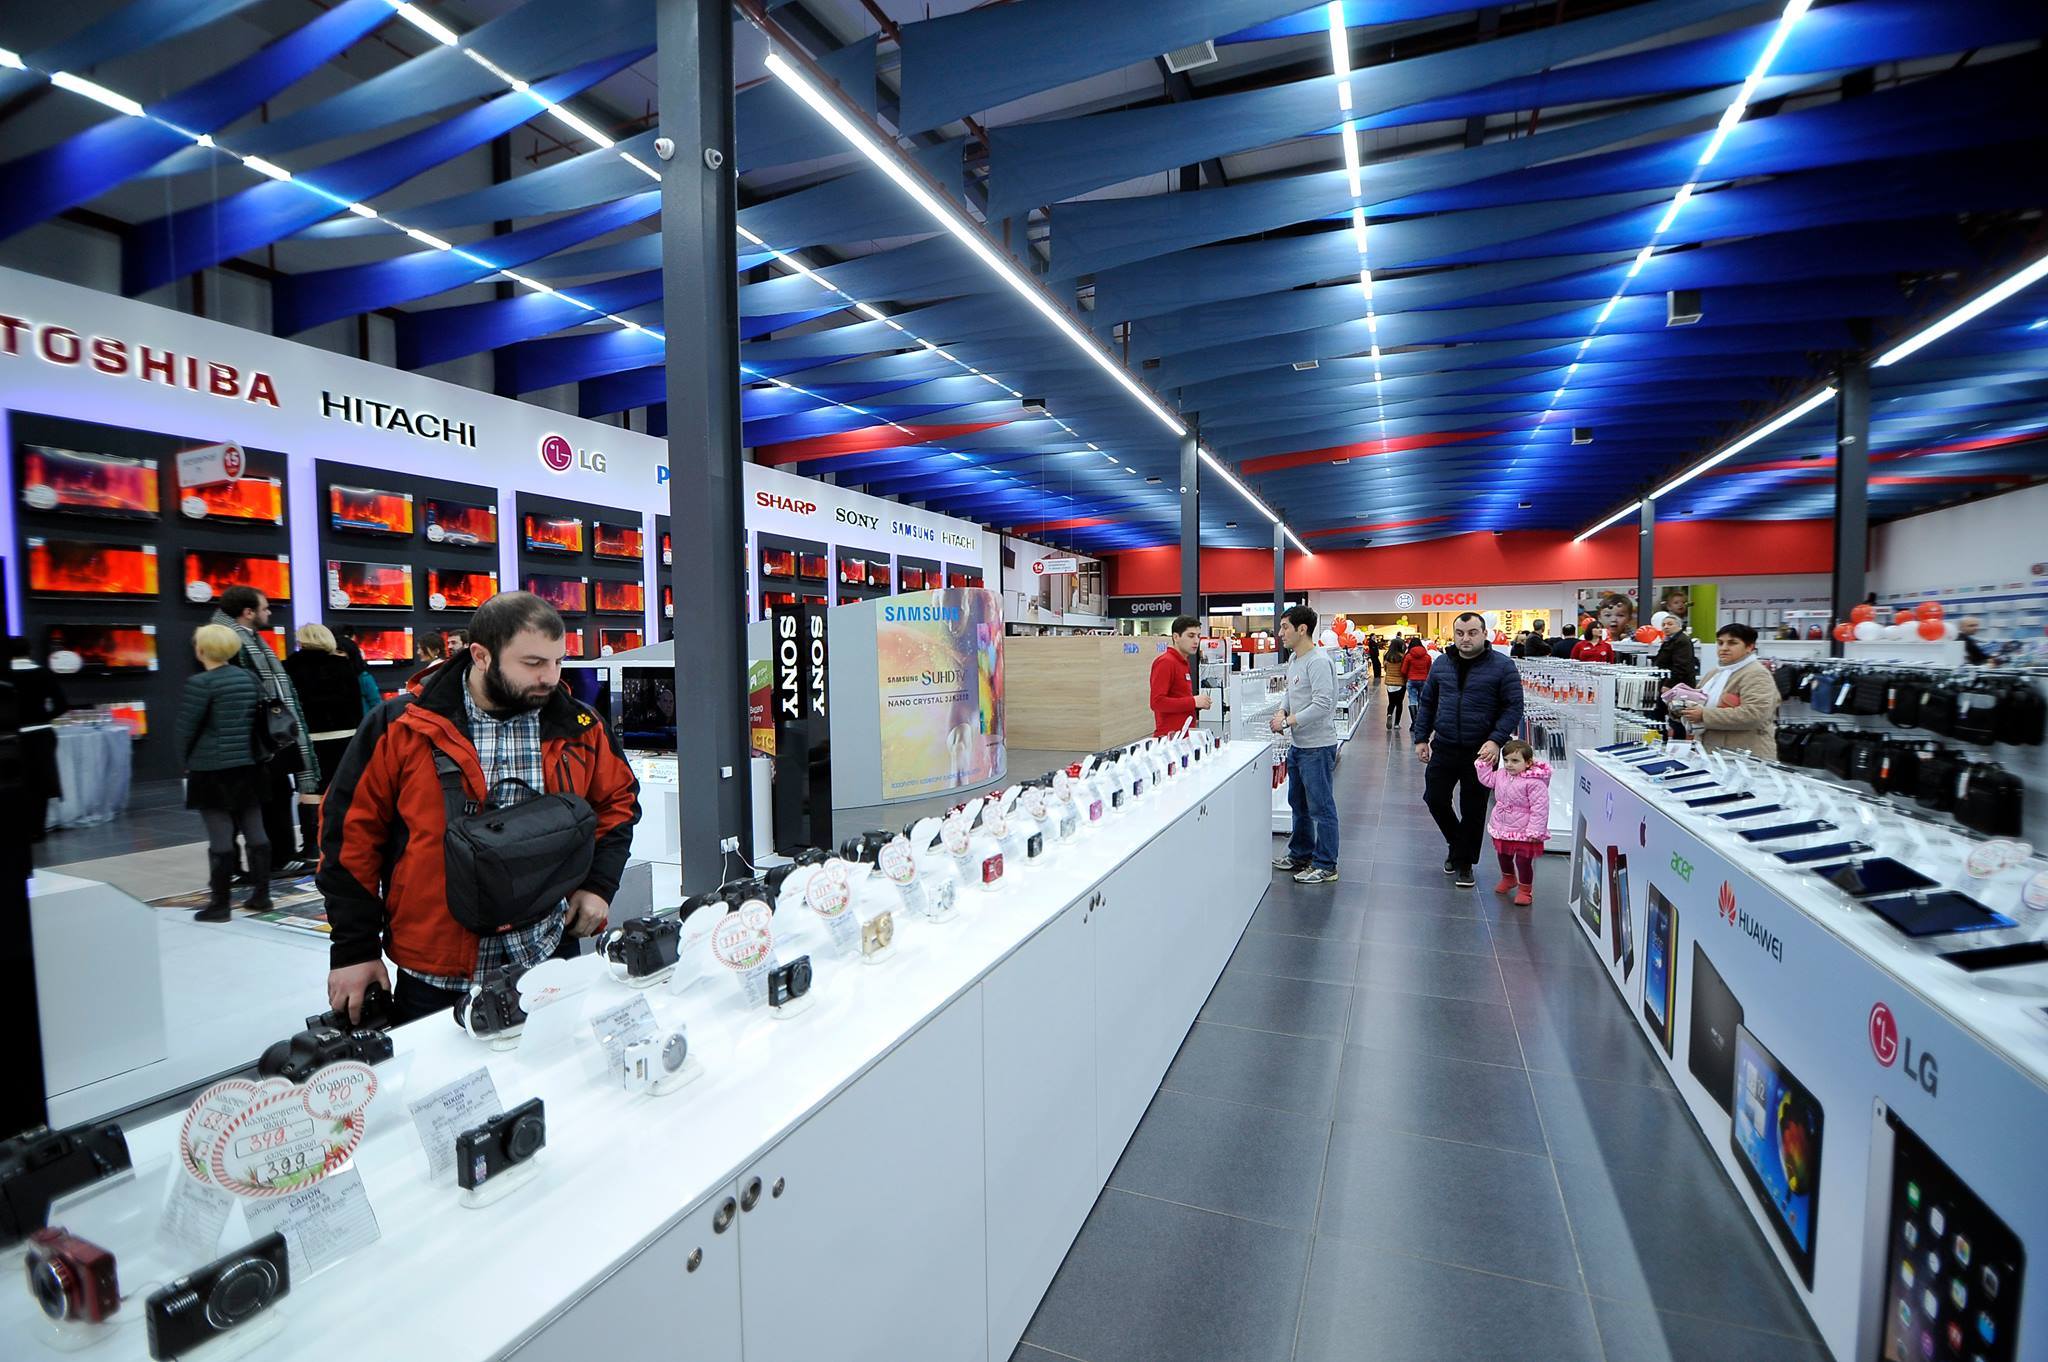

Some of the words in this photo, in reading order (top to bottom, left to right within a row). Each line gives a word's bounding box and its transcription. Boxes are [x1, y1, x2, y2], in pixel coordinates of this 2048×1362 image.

[0, 314, 280, 408] TOSHIBA
[322, 390, 477, 448] HITACHI
[580, 449, 607, 473] LG
[756, 491, 817, 515] SHARP
[835, 507, 879, 530] SONY
[892, 521, 935, 541] SAMSUNG
[942, 531, 975, 550] HITACHI
[1131, 601, 1173, 614] gorenje
[1421, 592, 1478, 606] BOSCH
[780, 615, 799, 719] SONY
[811, 615, 825, 717] SONY
[888, 699, 911, 707] NANO
[913, 697, 943, 706] CRYSTAL
[1670, 850, 1695, 884] acer
[1739, 909, 1783, 963] HUAWEI
[1904, 1036, 1938, 1099] LG
[443, 1093, 465, 1107] NIKON
[290, 1188, 321, 1208] CANON
